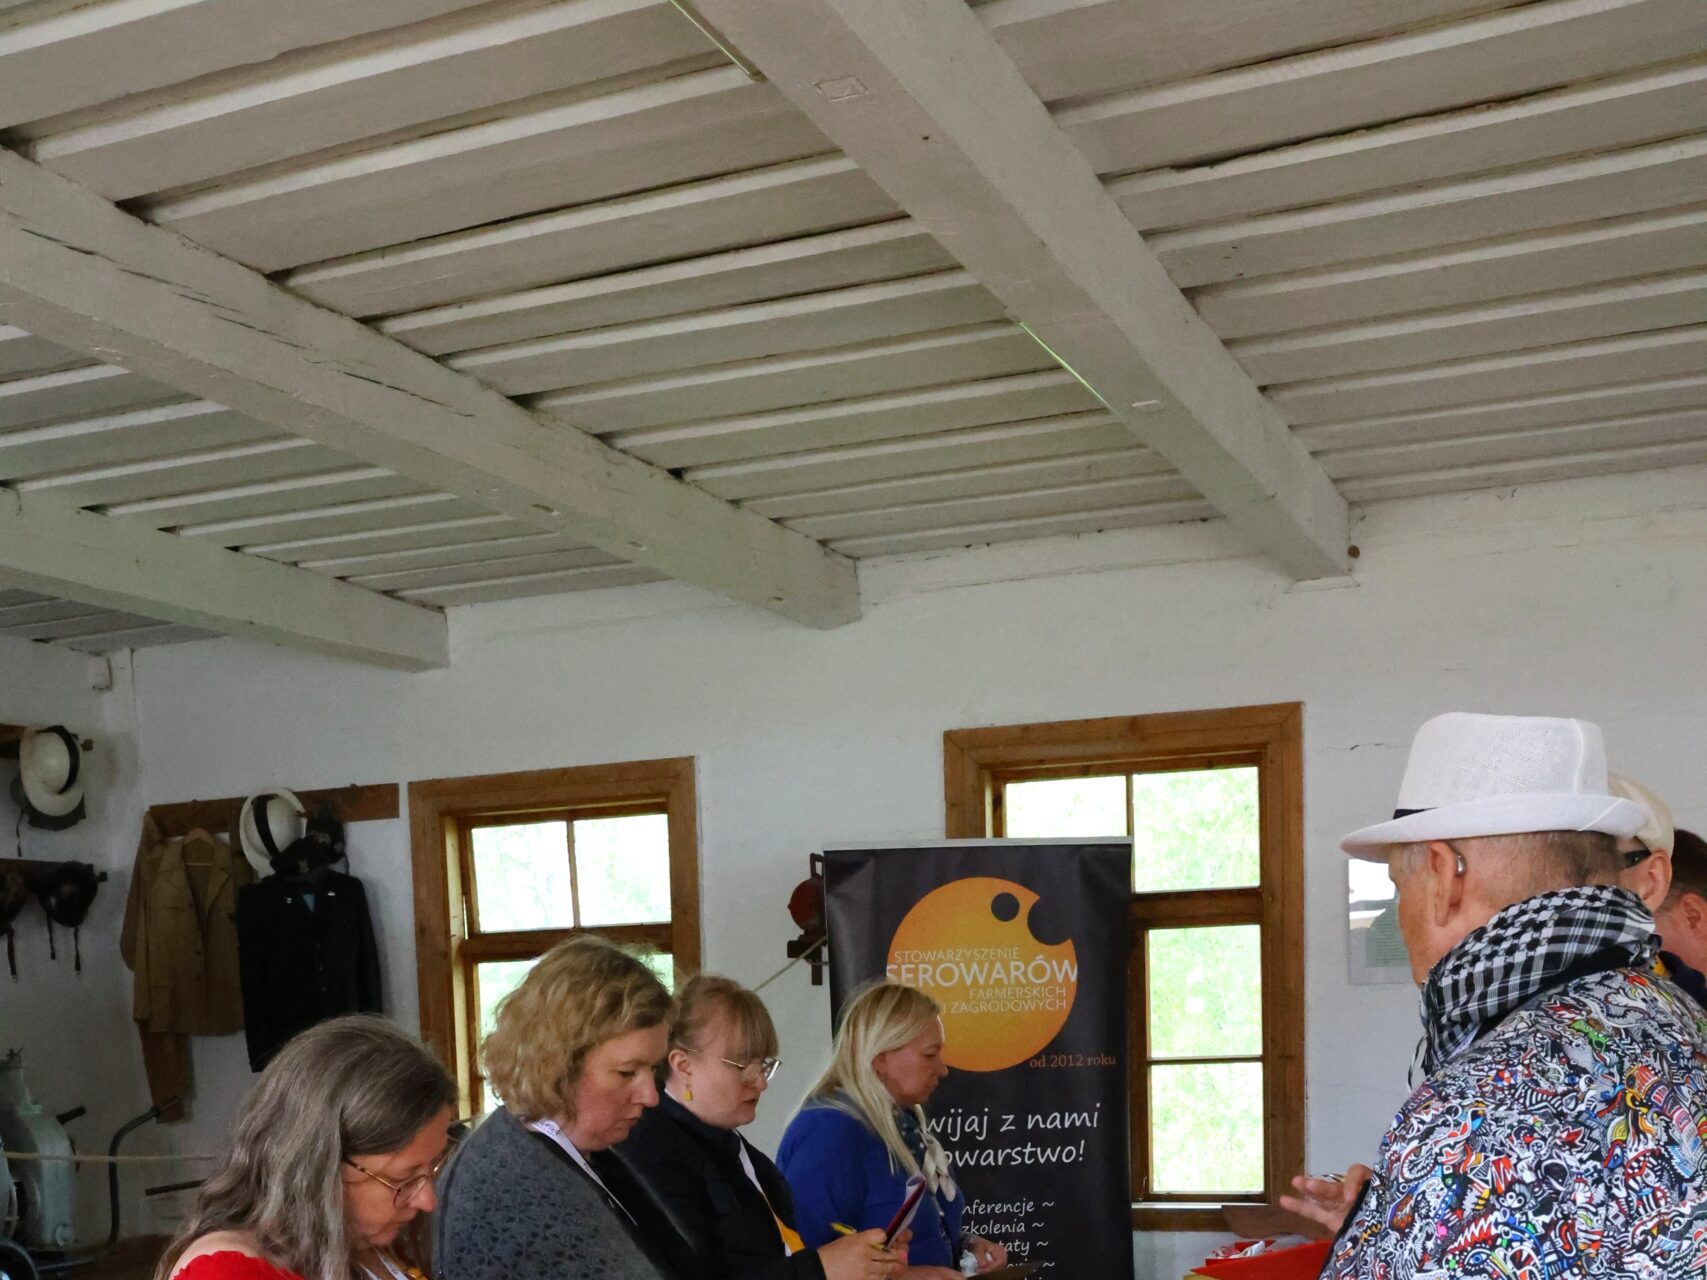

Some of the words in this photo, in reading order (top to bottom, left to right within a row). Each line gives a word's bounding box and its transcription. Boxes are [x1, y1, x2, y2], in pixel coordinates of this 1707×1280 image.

[894, 947, 1020, 963] STOWARZYSZENIE
[886, 954, 1078, 988] SEROWARÓW
[969, 986, 1066, 1000] FARMERSKICH
[951, 999, 1066, 1014] ZAGRODOWYCH
[1030, 1055, 1046, 1068] od
[1050, 1055, 1083, 1068] 2012
[1087, 1053, 1116, 1067] roku
[1000, 1114, 1016, 1132] z
[1027, 1103, 1101, 1130] nami
